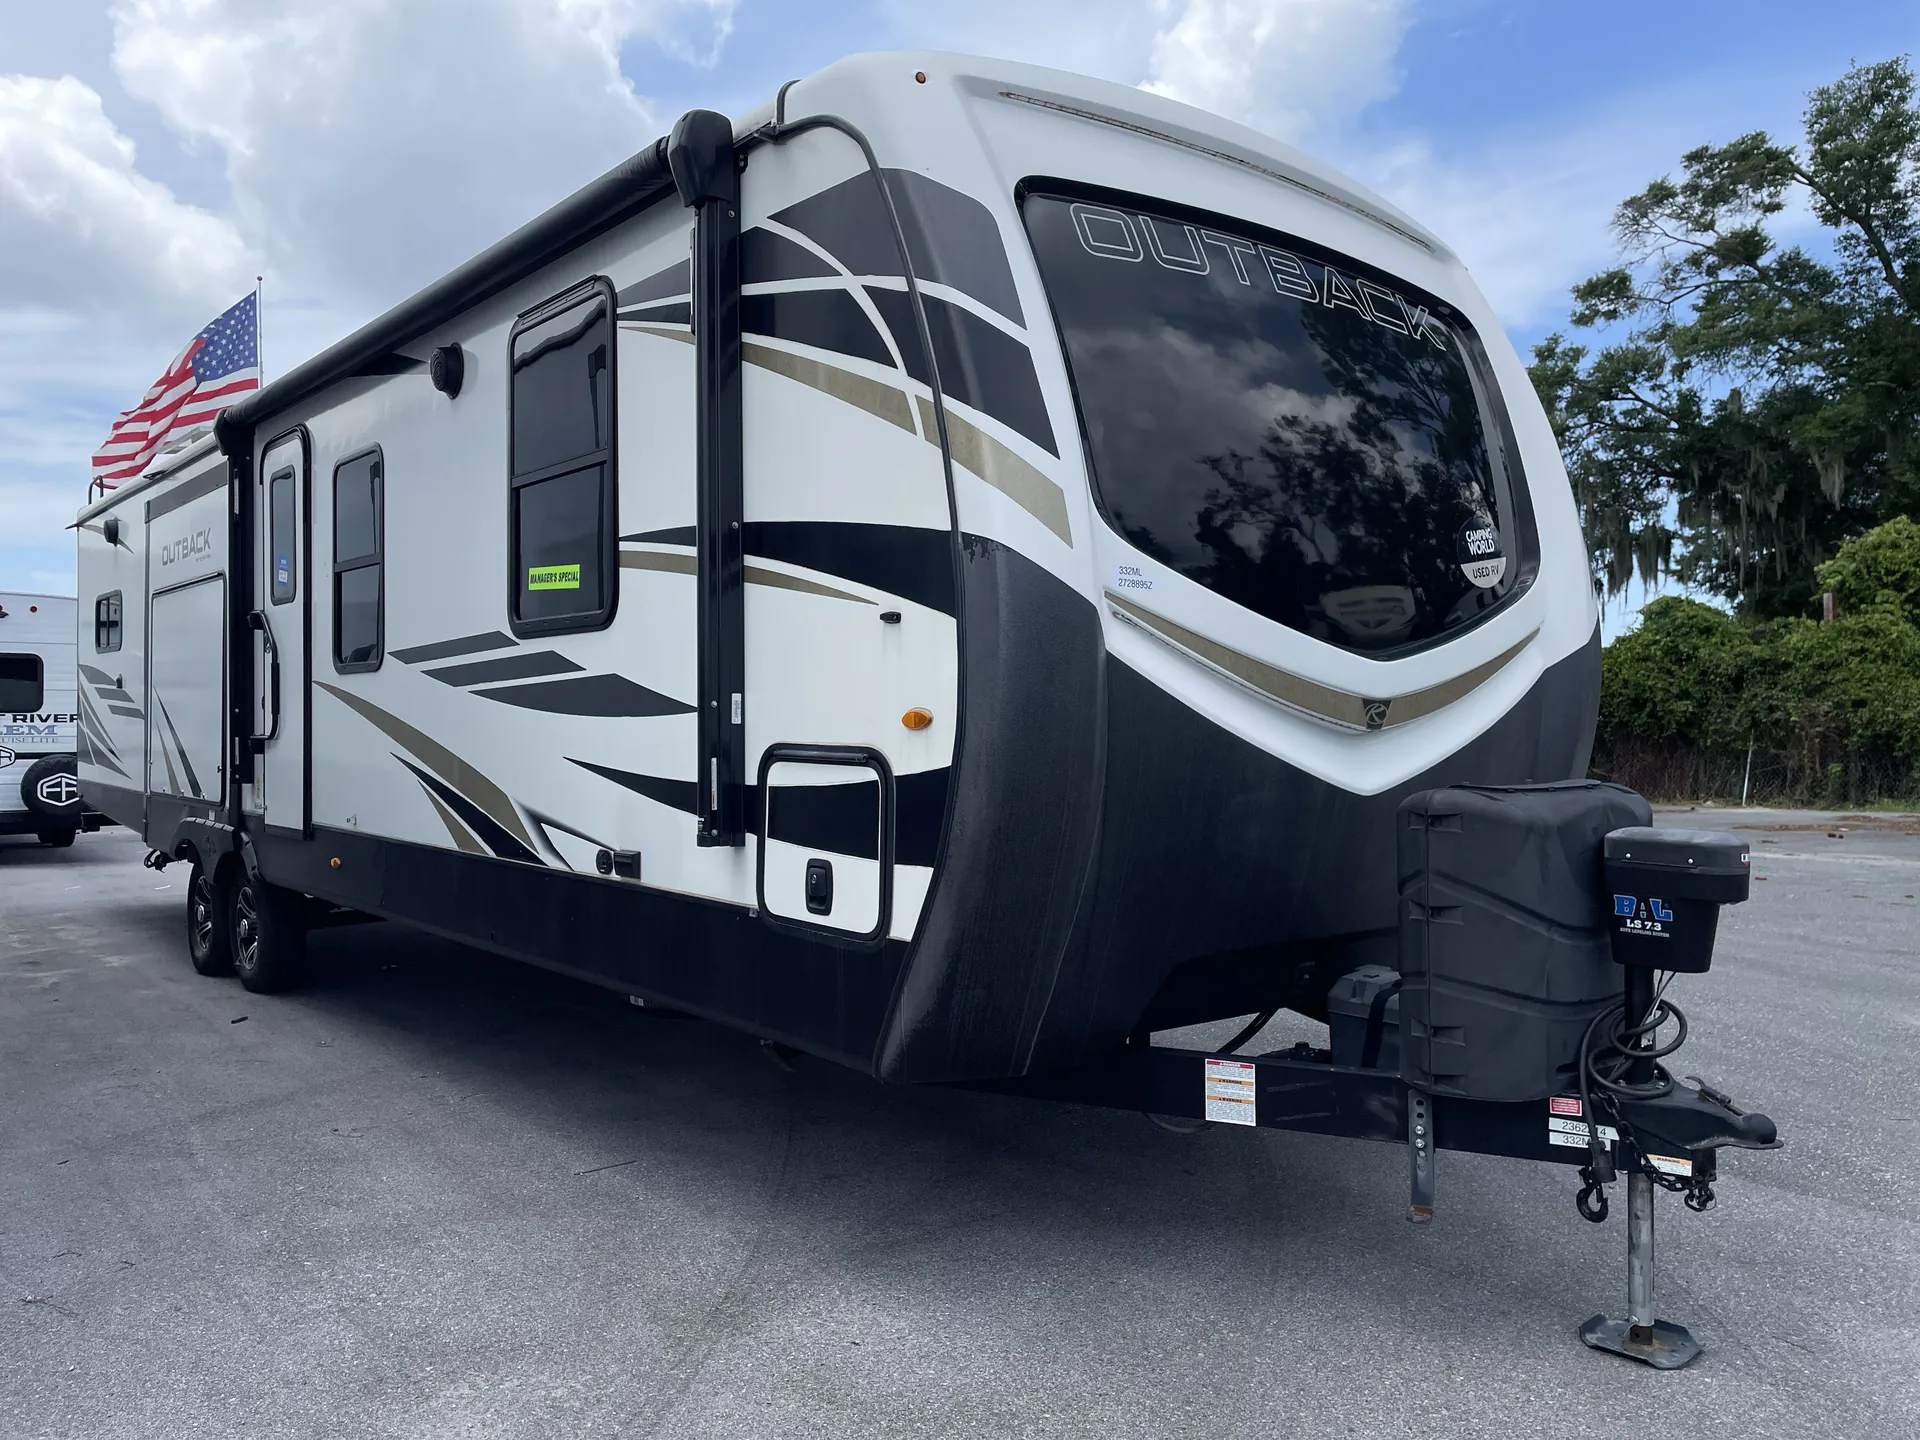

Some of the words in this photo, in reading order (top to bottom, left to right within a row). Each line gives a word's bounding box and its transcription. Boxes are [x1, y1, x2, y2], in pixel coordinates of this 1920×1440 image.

[1070, 203, 1446, 351] OUTBACK
[1466, 528, 1493, 542] CAMPING
[162, 527, 211, 566] OUTBACK
[1468, 540, 1495, 555] WORLD
[530, 572, 557, 584] MANAGER'S
[558, 571, 578, 582] SPECIAL
[1119, 566, 1142, 576] 332ML
[1472, 566, 1490, 579] USED
[1490, 564, 1499, 576] RV
[1626, 919, 1642, 929] LS
[1562, 1135, 1591, 1146] 332M
